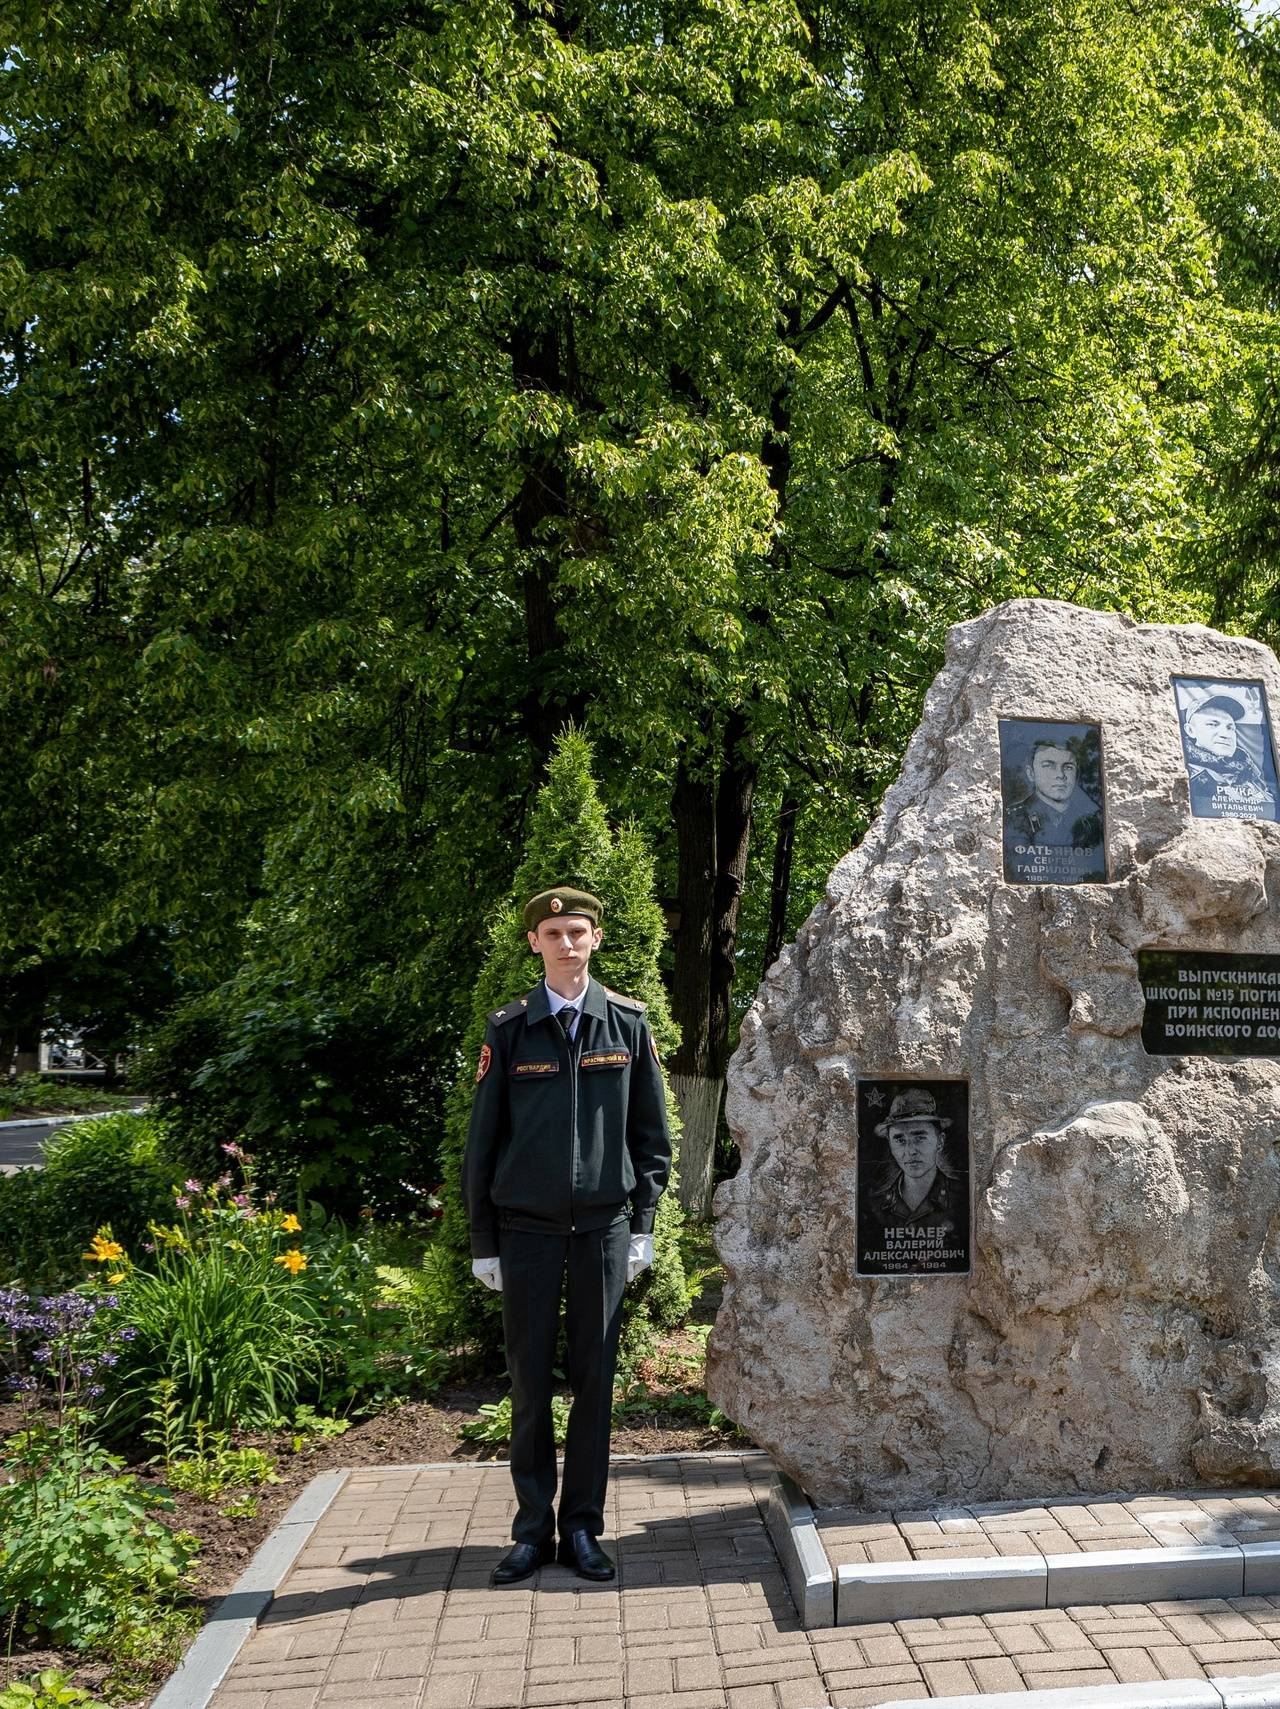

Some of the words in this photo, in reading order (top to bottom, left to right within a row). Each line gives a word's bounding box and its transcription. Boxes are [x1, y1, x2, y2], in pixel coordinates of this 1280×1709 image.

[1211, 794, 1262, 805] АЛЕКСАНДР
[1211, 802, 1264, 812] ВИТАЛЬЕВИЧ
[1014, 844, 1094, 857] ФАТЬЯНОВ
[1033, 856, 1076, 865] СЕРГЕЙ
[1017, 864, 1092, 875] ГАВРИЛОВИЧ
[1145, 986, 1201, 1001] ШКОЛЫ
[1206, 989, 1235, 1002] №15
[1167, 1005, 1198, 1020] ПРИ
[1165, 1024, 1252, 1038] ВОИНСКОГО
[884, 1226, 946, 1239] НЕЧАЕВ
[886, 1238, 944, 1250] ВАЛЕРИЙ
[863, 1250, 965, 1261] АЛЕКСАНДРОВИЧ
